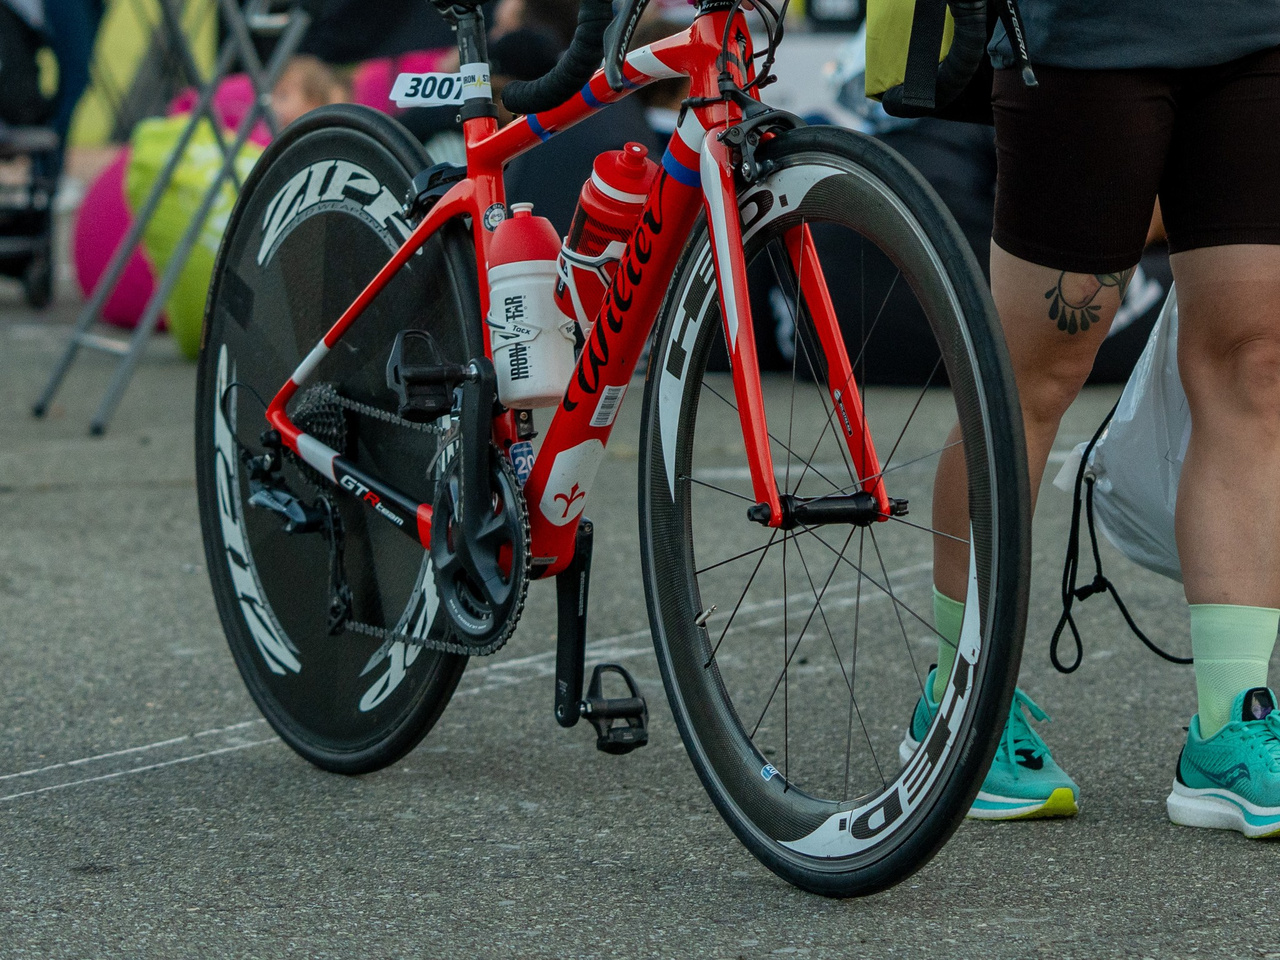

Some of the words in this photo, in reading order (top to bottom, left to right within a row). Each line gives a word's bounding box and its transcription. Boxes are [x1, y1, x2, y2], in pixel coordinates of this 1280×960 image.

[463, 74, 476, 85] IRON
[504, 295, 524, 322] TAR
[512, 324, 532, 335] Tacx
[508, 345, 530, 381] IRON
[340, 474, 381, 508] GTR
[374, 502, 405, 527] team
